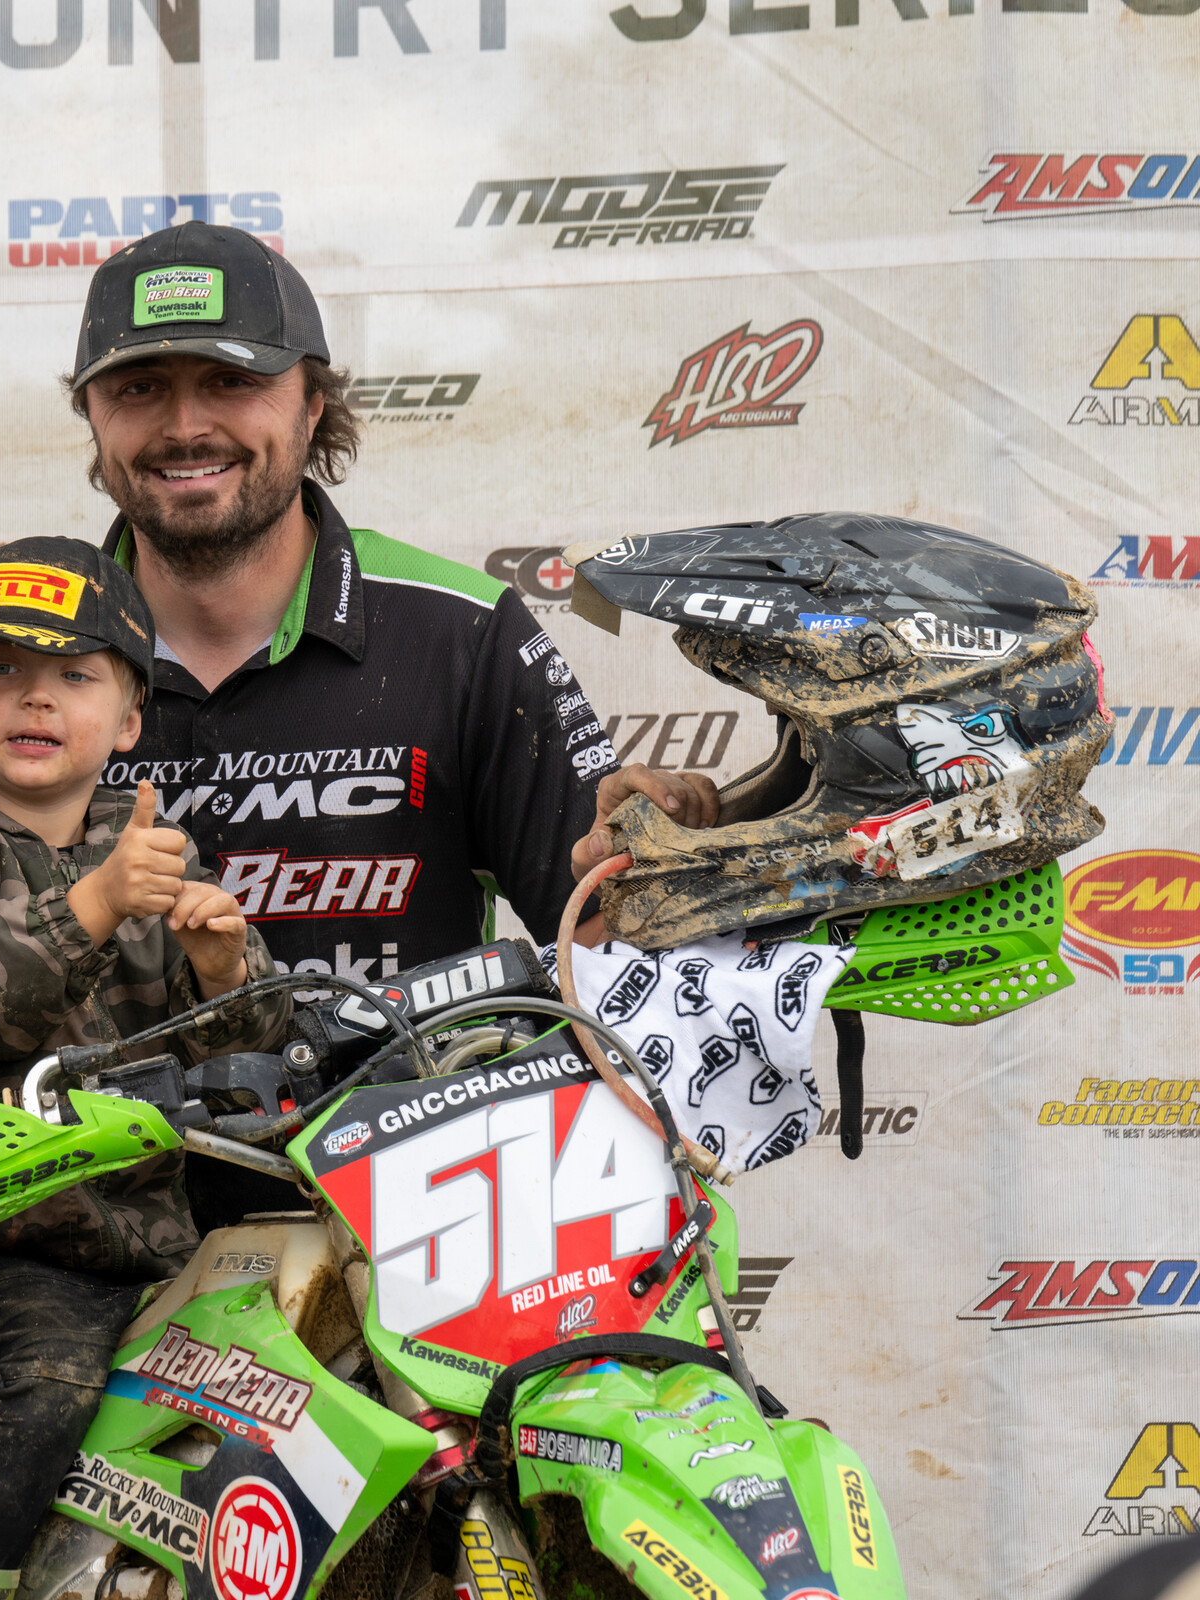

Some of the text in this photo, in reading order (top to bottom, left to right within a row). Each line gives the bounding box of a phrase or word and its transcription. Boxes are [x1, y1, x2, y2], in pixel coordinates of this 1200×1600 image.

[455, 163, 788, 228] MOOSE
[8, 192, 285, 239] PARTS
[552, 218, 753, 250] OFFROAD
[144, 286, 211, 303] RED BEAR
[147, 301, 207, 315] Kawasaki
[369, 411, 454, 423] Products
[719, 408, 793, 424] MOTOGRAFX
[334, 548, 352, 624] Kawasaki
[809, 617, 854, 632] M.E.D.S.
[209, 746, 407, 781] MOUNTAIN
[571, 737, 618, 779] SOS
[218, 850, 420, 918] BEAR
[832, 944, 1001, 989] ACERBIS
[1122, 954, 1185, 984] 50
[604, 962, 655, 1018] SHOEI
[1123, 986, 1148, 996] YEARS
[1158, 986, 1185, 996] POWER
[1075, 1077, 1200, 1103] Factor
[327, 1124, 369, 1152] GNCC
[1103, 1128, 1200, 1139] THE BEST SUSPENSIO
[371, 1074, 682, 1336] 514
[671, 1219, 700, 1258] IMS
[210, 1253, 277, 1274] IMS
[511, 1263, 616, 1314] RED LINE OIL
[142, 1322, 313, 1431] RED BEAR
[159, 1391, 251, 1437] RACING
[537, 1427, 623, 1474] YOSHIMURA
[87, 1457, 203, 1528] ROCKY MOUNTAIN
[712, 1474, 762, 1502] TEAM
[846, 1468, 876, 1567] ACERBIS
